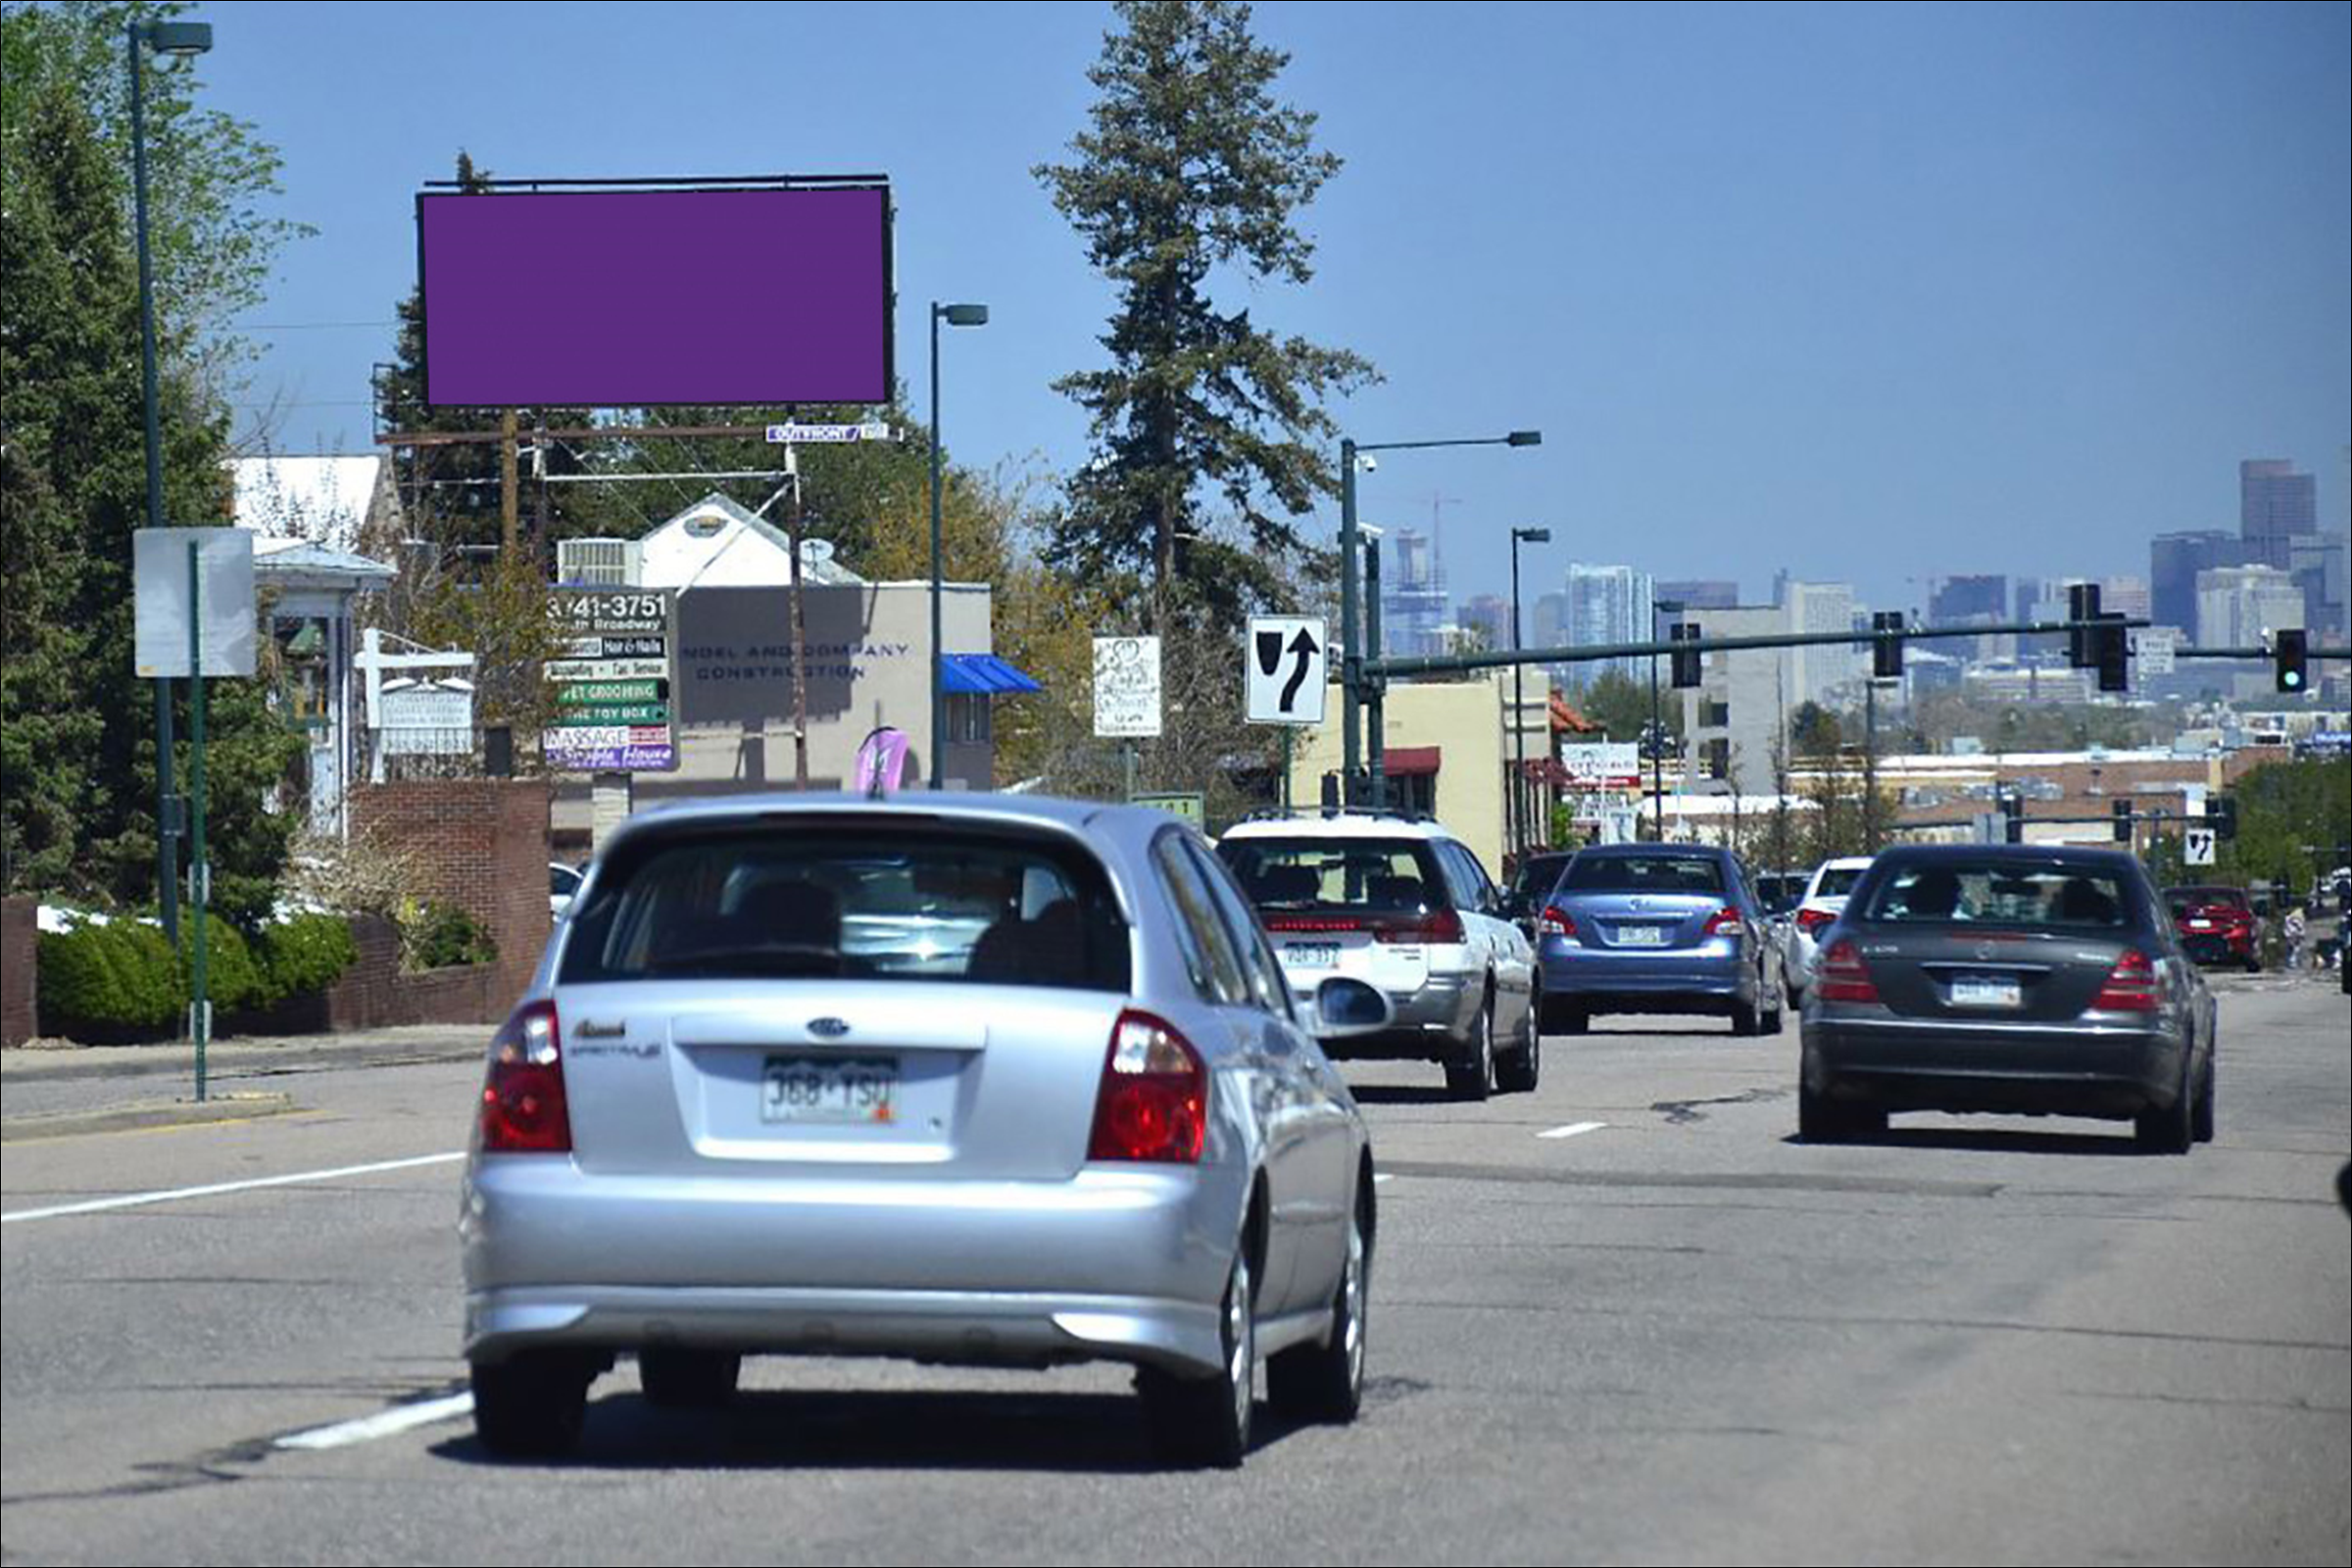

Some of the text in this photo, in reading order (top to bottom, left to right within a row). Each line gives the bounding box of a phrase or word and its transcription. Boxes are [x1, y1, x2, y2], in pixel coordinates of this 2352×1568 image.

[594, 618, 662, 630] Broadway
[683, 643, 909, 659] NOEL AND COMPANY
[588, 684, 655, 699] GROOMING
[594, 707, 620, 718] TOY
[622, 707, 648, 718] BOX
